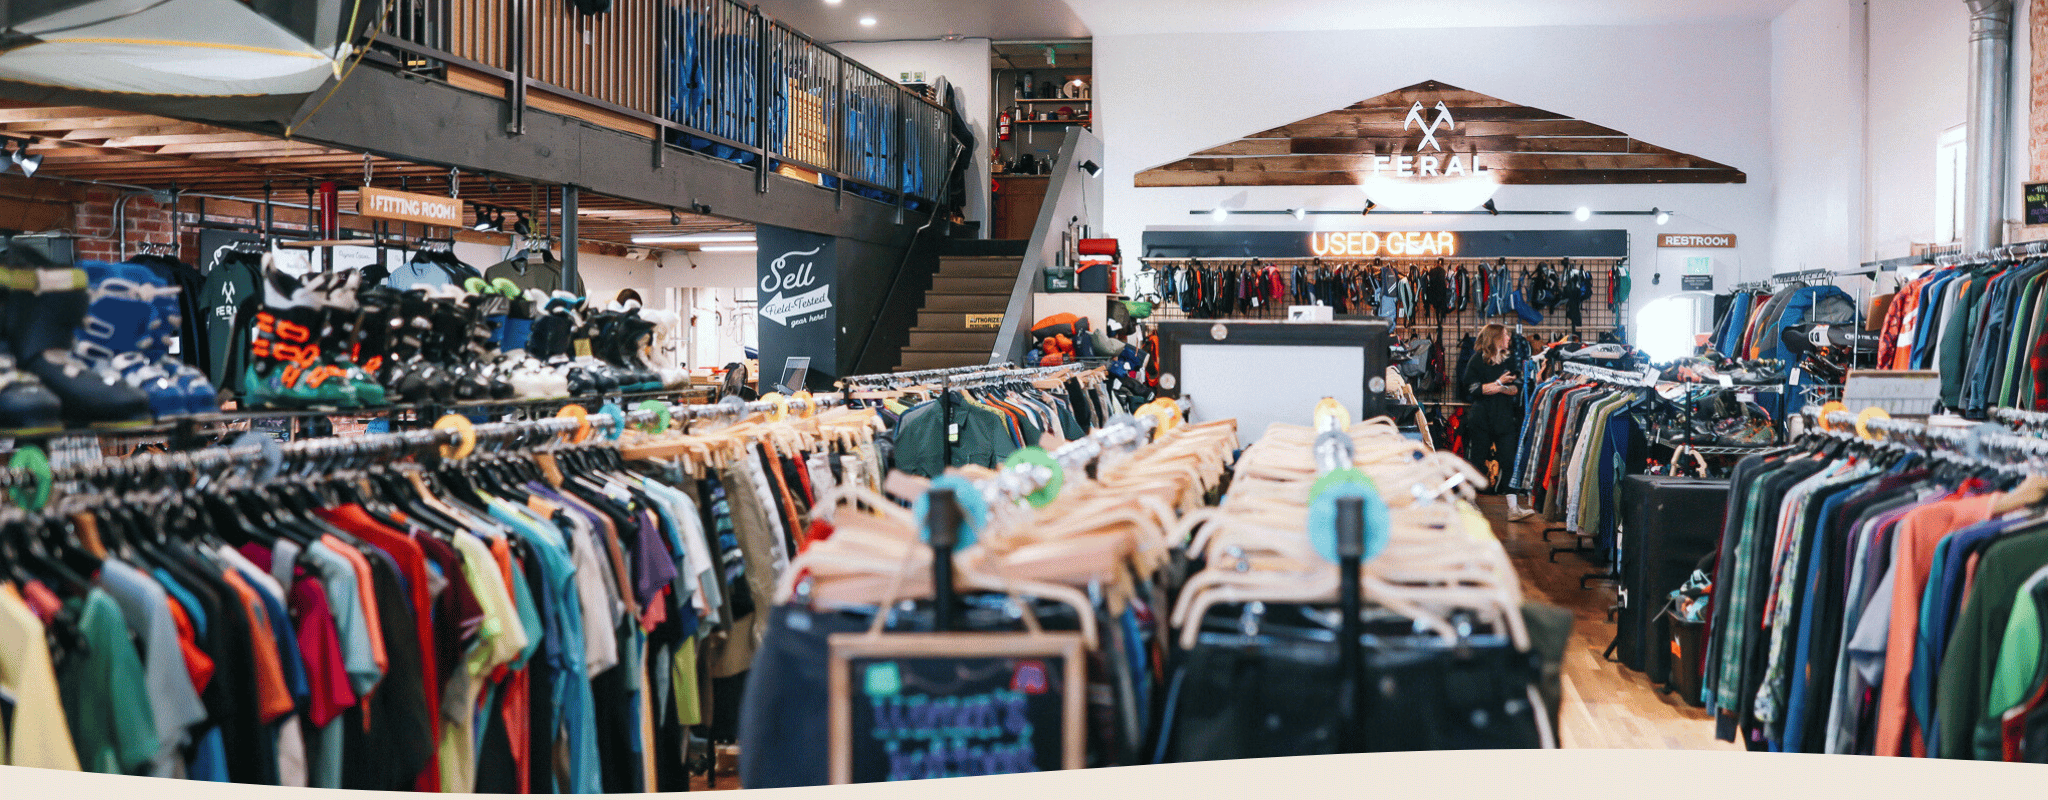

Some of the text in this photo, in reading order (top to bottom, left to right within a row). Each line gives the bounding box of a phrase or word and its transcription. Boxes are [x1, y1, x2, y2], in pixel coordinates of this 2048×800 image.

[1373, 155, 1489, 177] FERAL
[375, 194, 452, 220] FITTING ROOM
[1311, 231, 1455, 256] USED GEAR
[1665, 236, 1729, 246] RESTROOM
[760, 246, 820, 293] Sell
[215, 305, 238, 317] FERA
[765, 292, 826, 316] Field-Tested
[790, 309, 828, 329] gear here!
